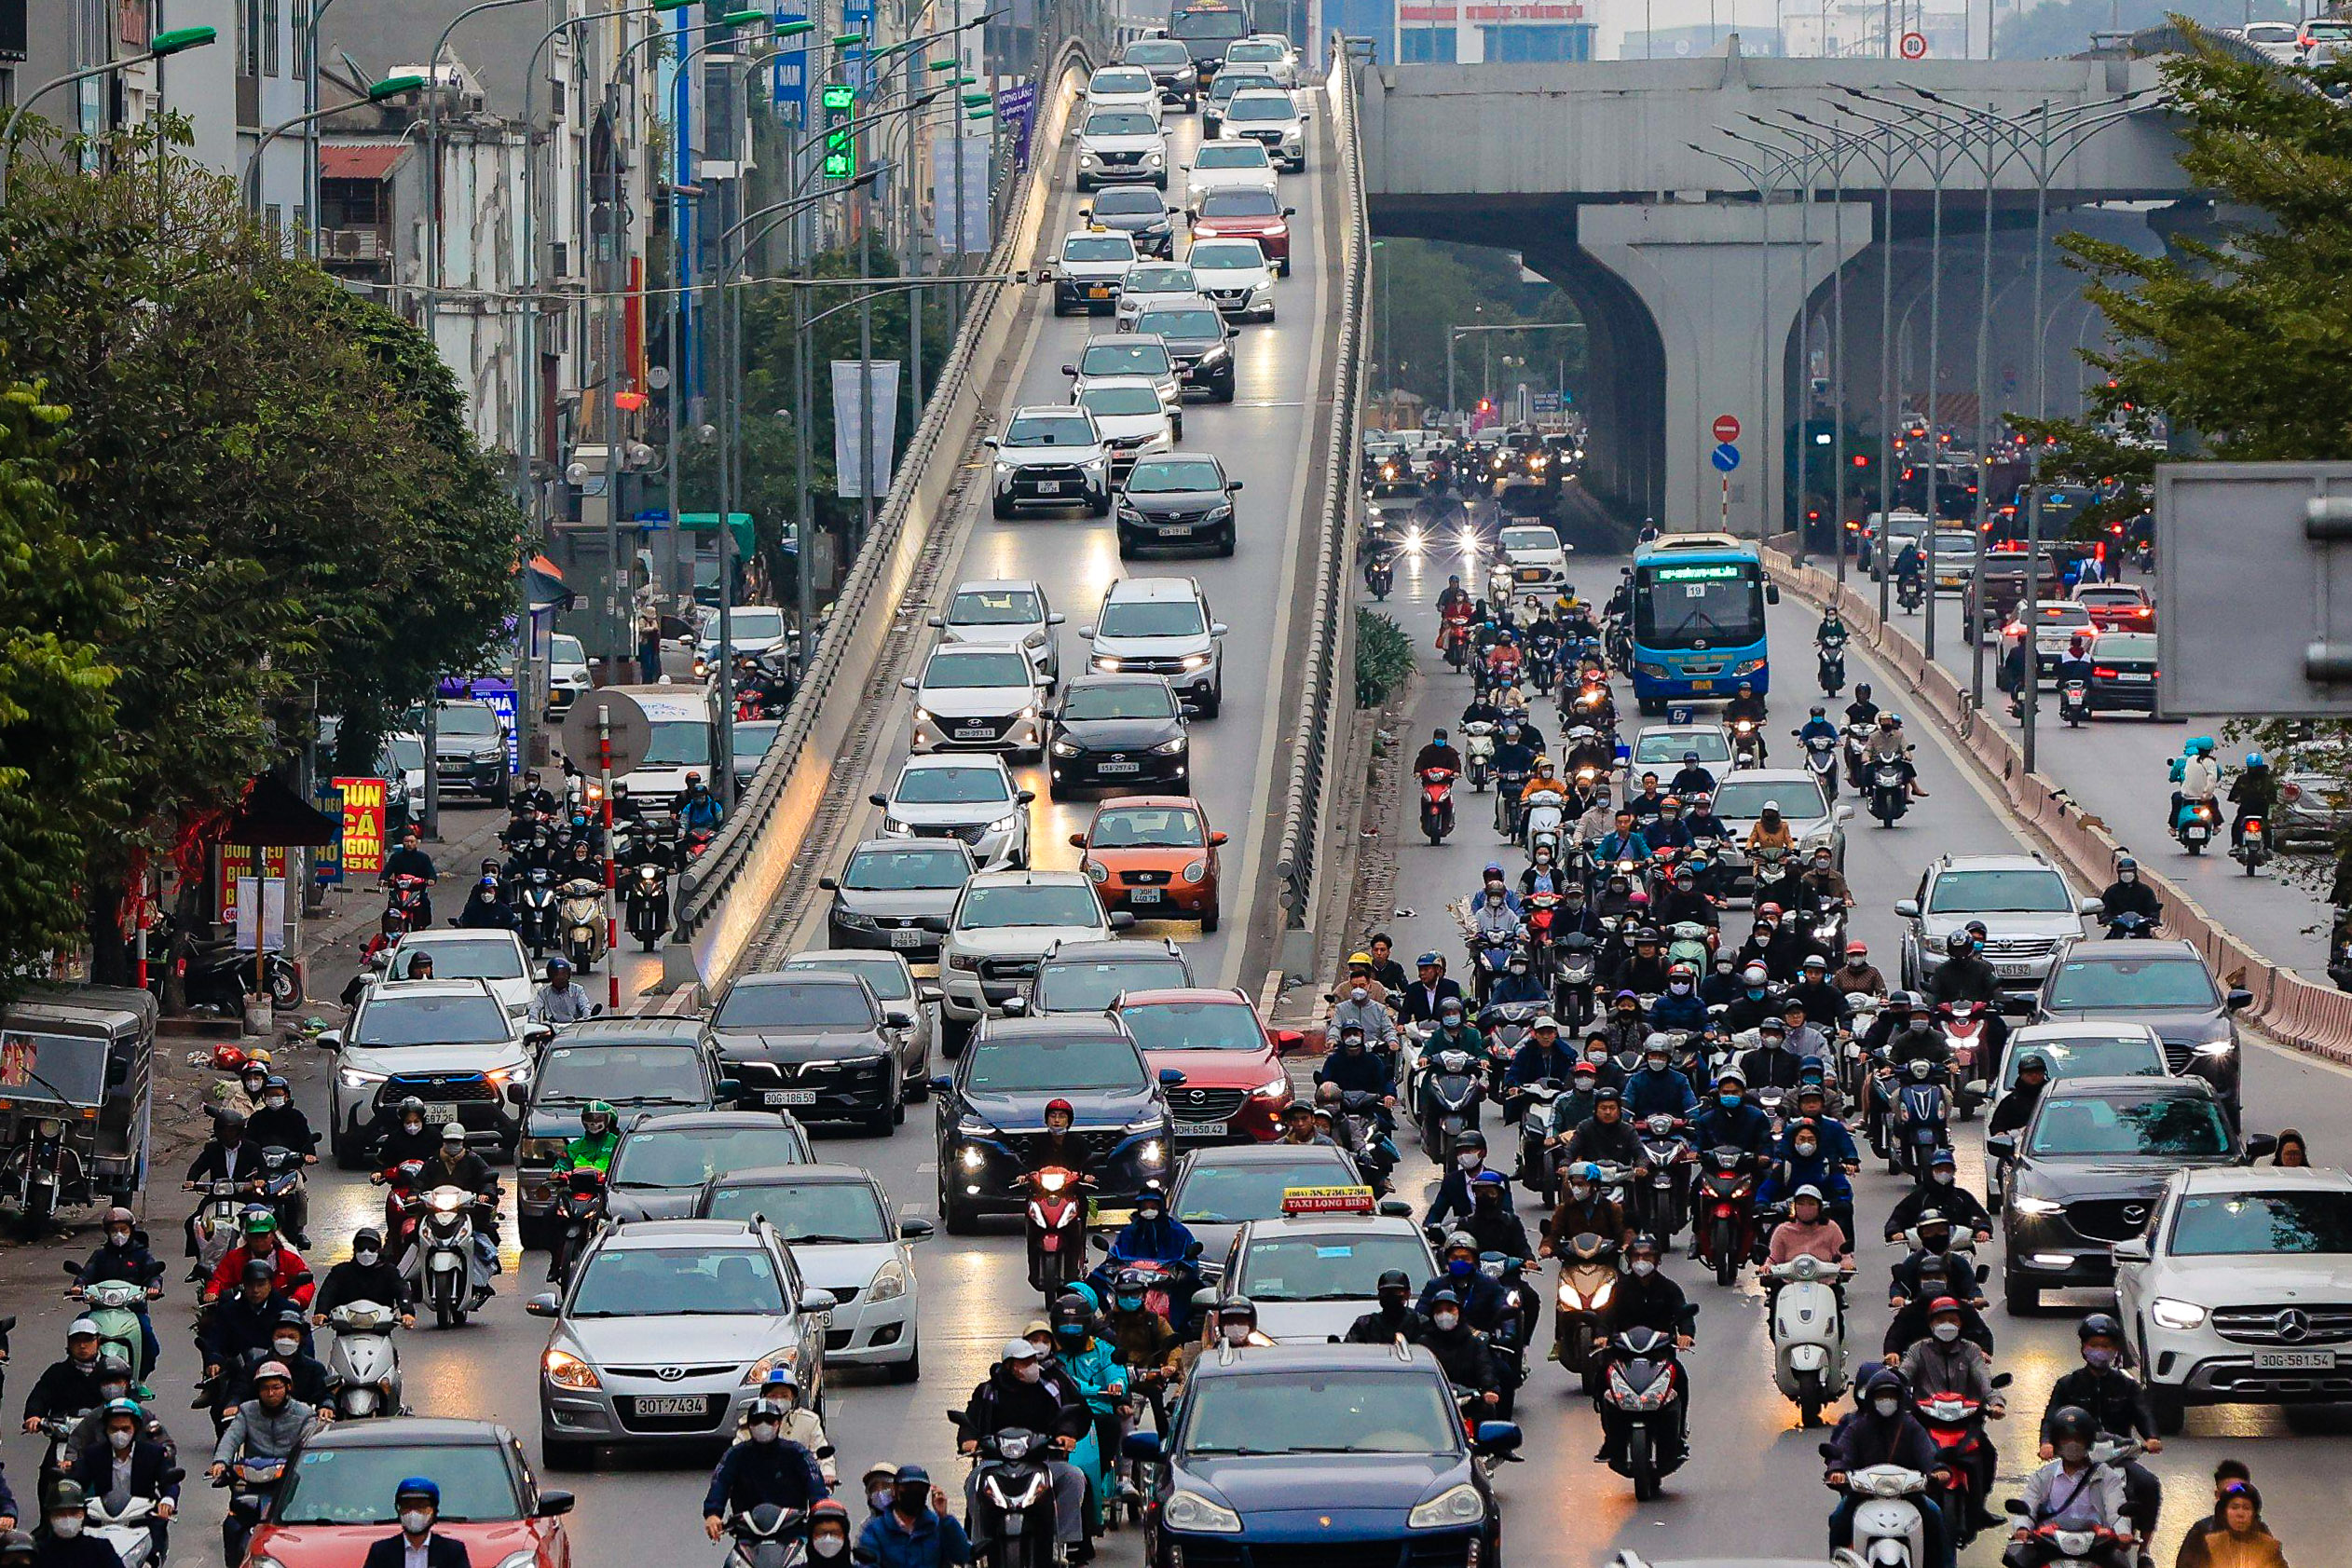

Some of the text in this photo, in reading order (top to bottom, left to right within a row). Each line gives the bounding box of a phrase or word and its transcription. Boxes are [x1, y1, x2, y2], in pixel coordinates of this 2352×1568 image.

[1908, 40, 1920, 52] 80
[336, 780, 380, 808] BÚN
[343, 810, 377, 837] CÁ
[431, 1105, 447, 1114] 30G
[1288, 1196, 1370, 1208] TAXI LONG BIÊN
[2261, 1355, 2329, 1367] 30G-581.54
[639, 1398, 703, 1413] 30T-7434
